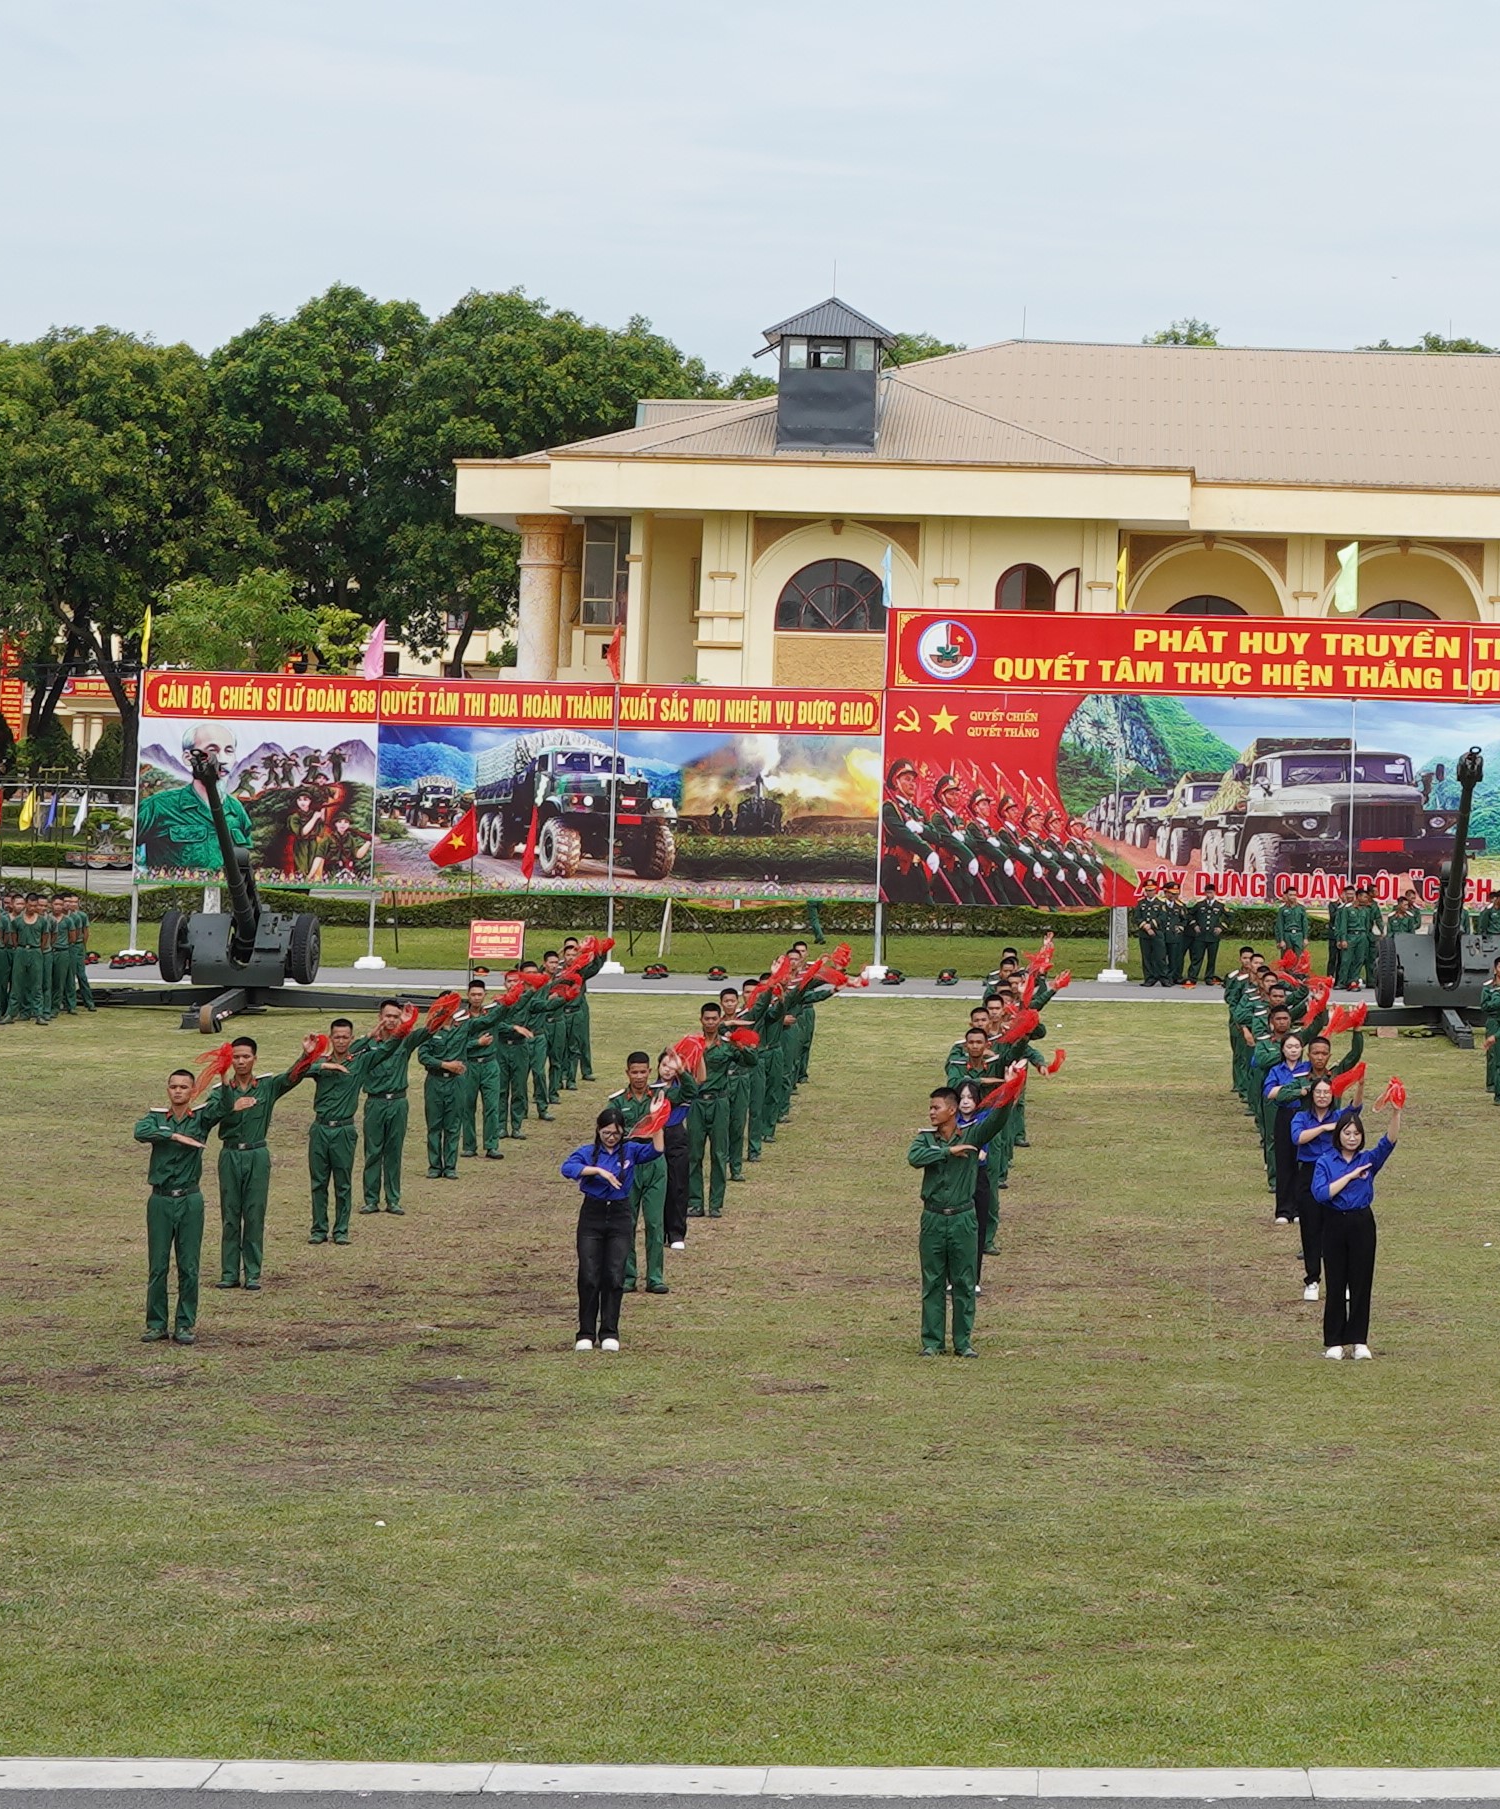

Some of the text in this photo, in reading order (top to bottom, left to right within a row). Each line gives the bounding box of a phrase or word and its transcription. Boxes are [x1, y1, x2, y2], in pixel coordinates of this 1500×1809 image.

[1135, 626, 1228, 652] PHÁT
[1240, 632, 1310, 654] HUY
[1321, 629, 1460, 658] TRUYỀN
[994, 652, 1089, 681] QUYẾT
[1098, 656, 1163, 682] TÂM
[1174, 661, 1251, 688] THỰC
[1262, 660, 1332, 690] HIỆN
[1343, 660, 1442, 689] THẮNG
[1453, 668, 1500, 696] LỢI
[159, 680, 188, 708] CÁN
[192, 681, 214, 714] BỘ,
[220, 676, 264, 710] CHIẾN
[267, 684, 282, 711] SĨ
[285, 683, 305, 711] LỮ
[307, 684, 346, 712] ĐOÀN
[350, 690, 376, 713] 368
[381, 684, 425, 716] QUYẾT
[429, 688, 459, 715] TÂM
[464, 693, 485, 716] THI
[489, 694, 518, 717] ĐUA
[523, 691, 562, 718] HOÀN
[566, 691, 612, 719] THÀNH
[619, 689, 657, 721] XUẤT
[660, 692, 688, 721] SẮC
[693, 699, 721, 727] MỌI
[725, 696, 771, 728] NHIỆM
[776, 701, 794, 729] VỤ
[798, 700, 836, 732] ĐƯỢC
[840, 702, 873, 725] GIAO
[970, 709, 1038, 721] QUYẾT CHIẾN
[967, 724, 1039, 737] QUYẾT THẮNG
[1135, 866, 1186, 895] XÂY
[1276, 870, 1346, 899] QUÂN
[1356, 870, 1399, 905] ĐỘI
